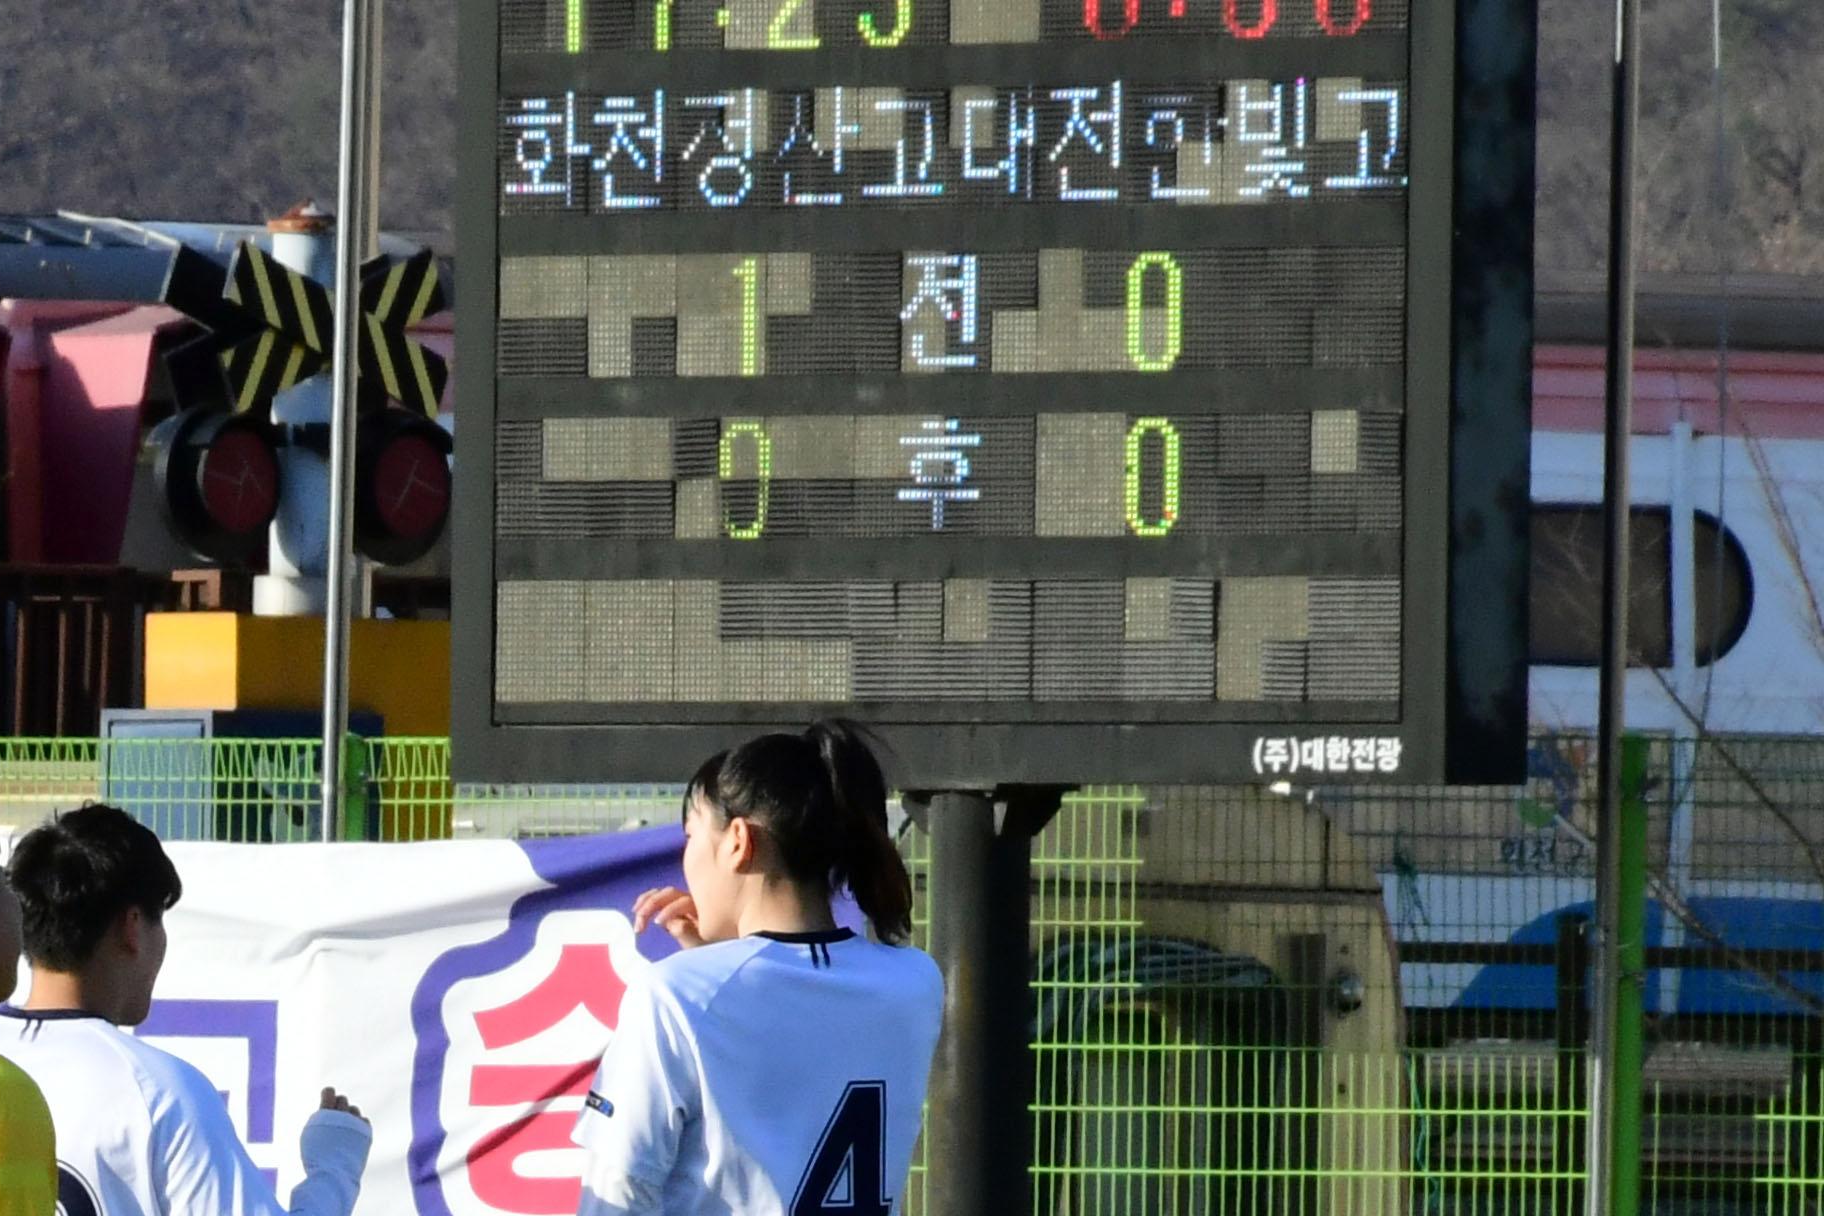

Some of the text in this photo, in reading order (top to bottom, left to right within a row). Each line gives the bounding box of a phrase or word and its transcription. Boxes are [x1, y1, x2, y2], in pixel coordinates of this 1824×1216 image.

[732, 250, 1183, 377] 1 전 0
[718, 415, 1181, 541] 0 후 0
[1252, 735, 1403, 775] (주)대한전광
